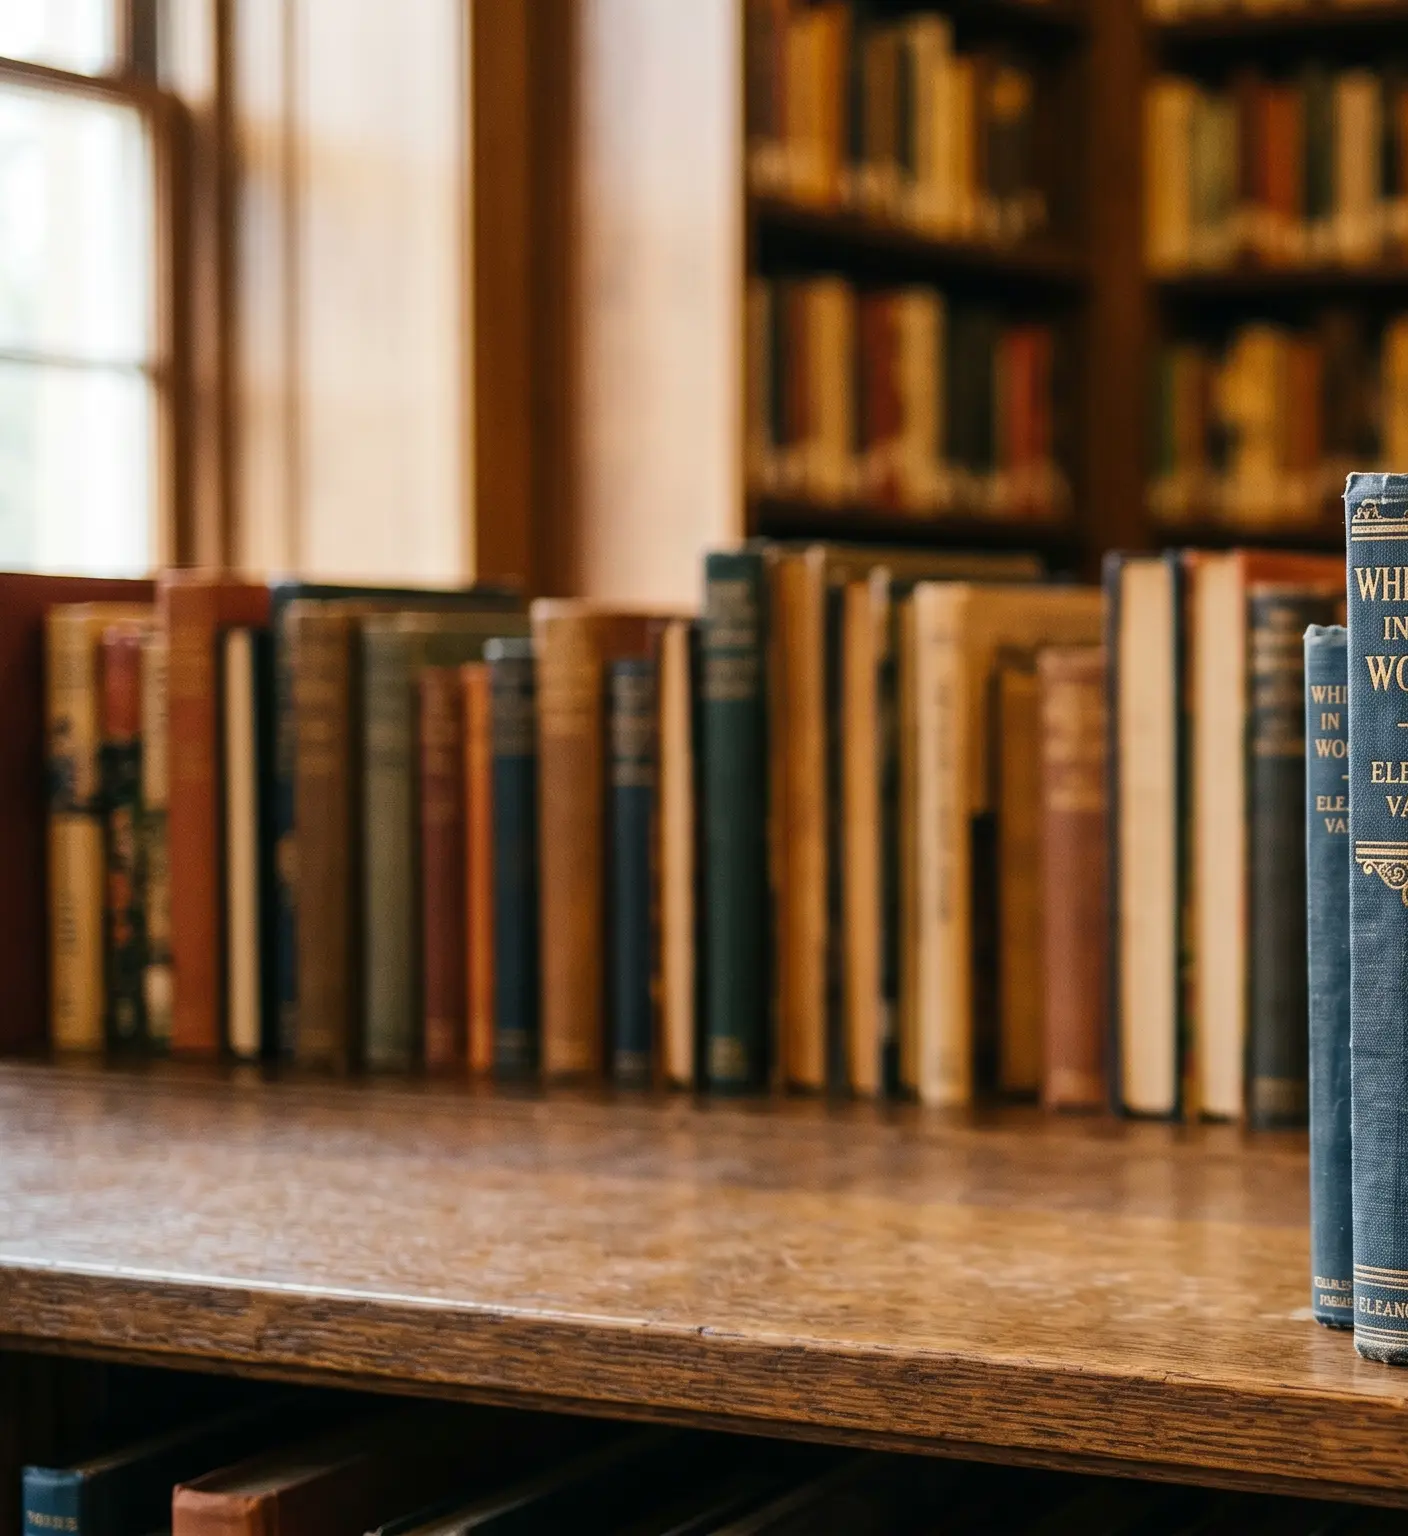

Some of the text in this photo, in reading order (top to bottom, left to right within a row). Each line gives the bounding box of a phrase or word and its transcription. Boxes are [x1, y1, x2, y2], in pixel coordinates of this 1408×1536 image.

[1320, 711, 1340, 731] IN
[1315, 738, 1350, 759] WO
[1315, 795, 1350, 812] ELE
